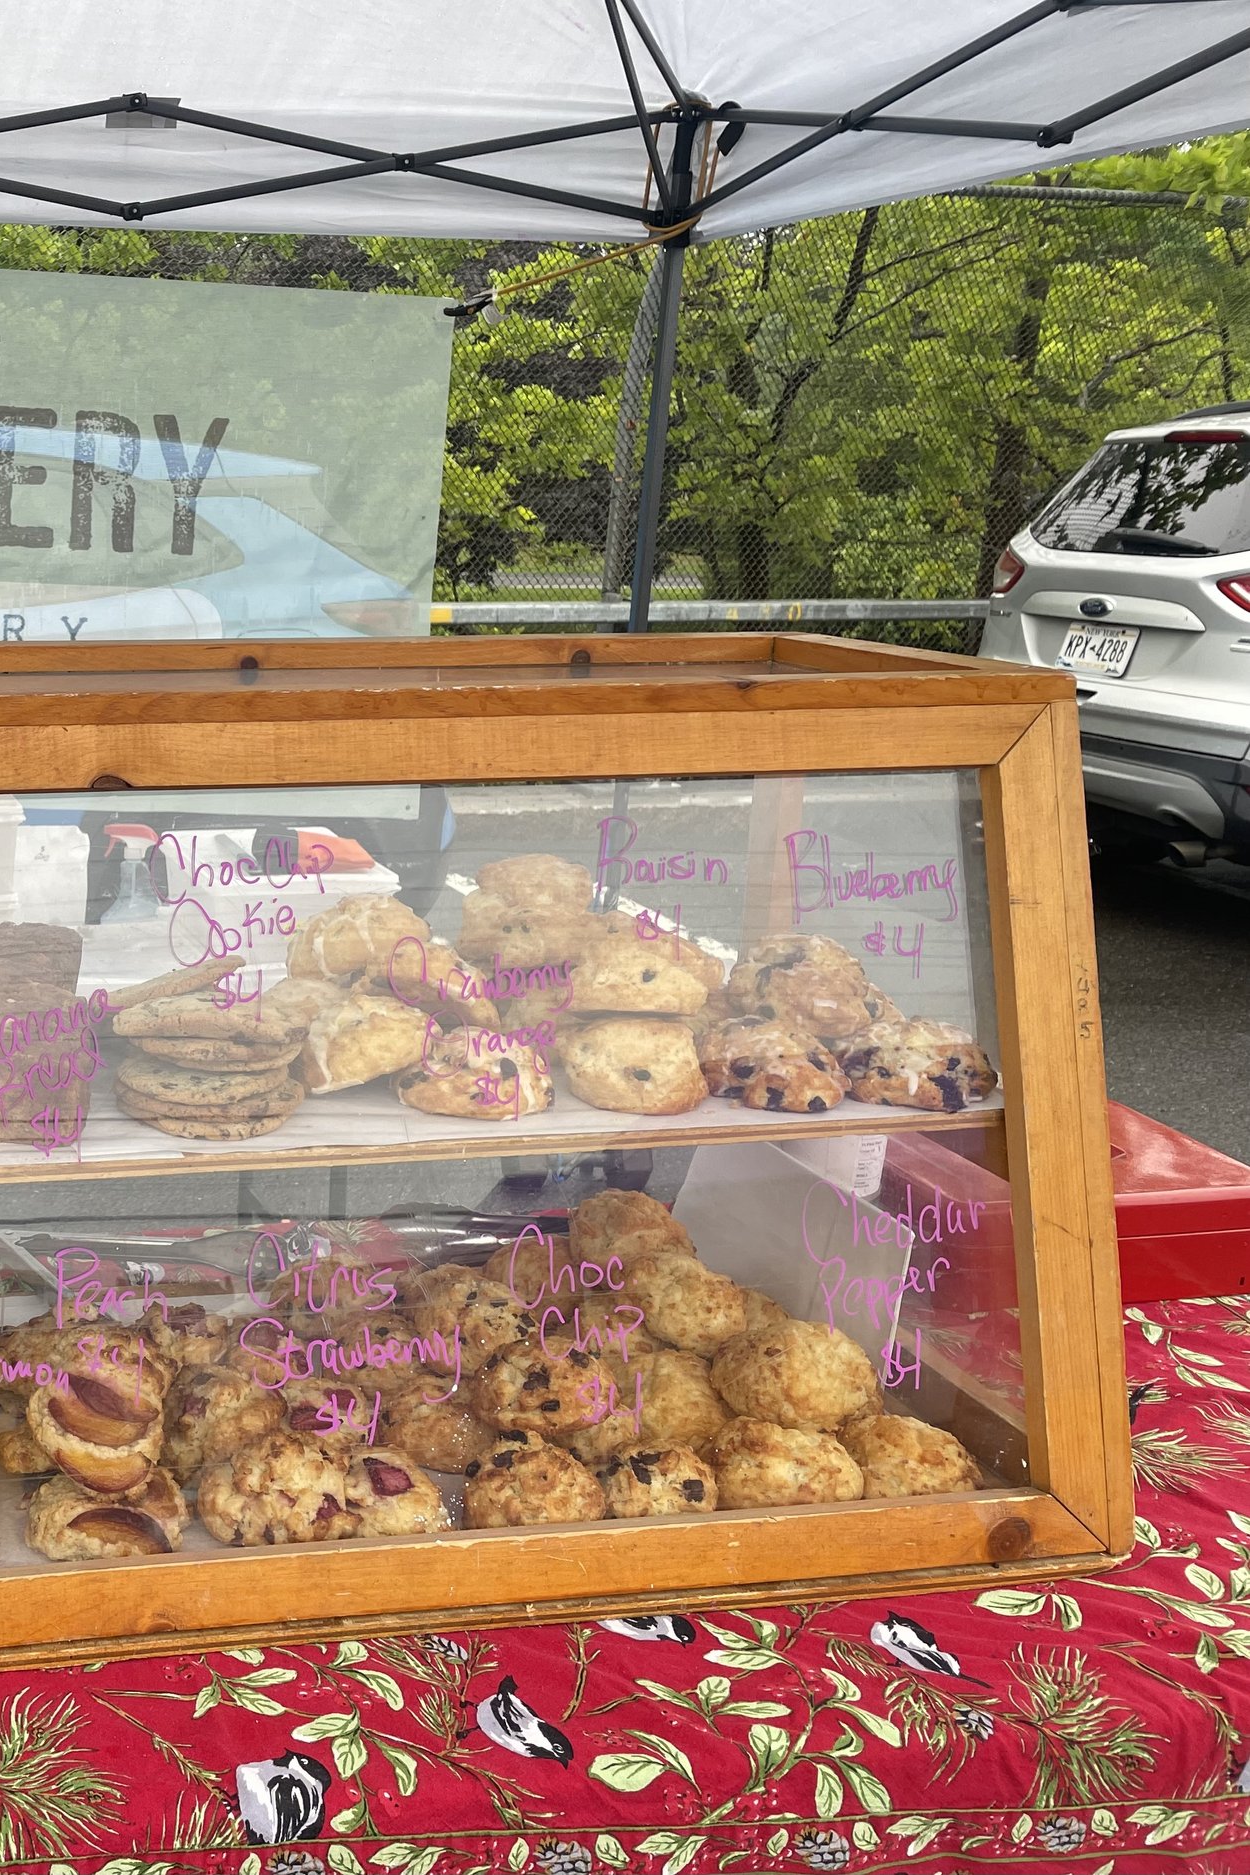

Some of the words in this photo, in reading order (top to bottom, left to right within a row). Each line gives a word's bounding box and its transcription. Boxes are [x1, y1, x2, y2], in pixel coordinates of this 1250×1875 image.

[150, 833, 260, 905] Choc
[265, 837, 335, 894] Chip
[597, 815, 728, 892] Raisin
[783, 828, 958, 924] Blueberry
[169, 898, 296, 968] Cookie
[635, 903, 682, 962] $4
[860, 922, 924, 978] $4
[211, 969, 262, 1021] $4
[388, 936, 574, 1014] Cranberry
[422, 1009, 557, 1078] Orange
[474, 1071, 520, 1121] $4
[31, 1105, 83, 1163] $4
[802, 1179, 987, 1266] Cheddar
[53, 1246, 169, 1329] Peach
[247, 1232, 398, 1313] Citrus
[817, 1255, 951, 1335] Pepper
[240, 1317, 461, 1404] Strawberry
[540, 1305, 645, 1363] Chip
[878, 1328, 922, 1390] $4
[77, 1336, 147, 1406] $4
[577, 1372, 643, 1434] $4
[314, 1391, 381, 1446] $4
